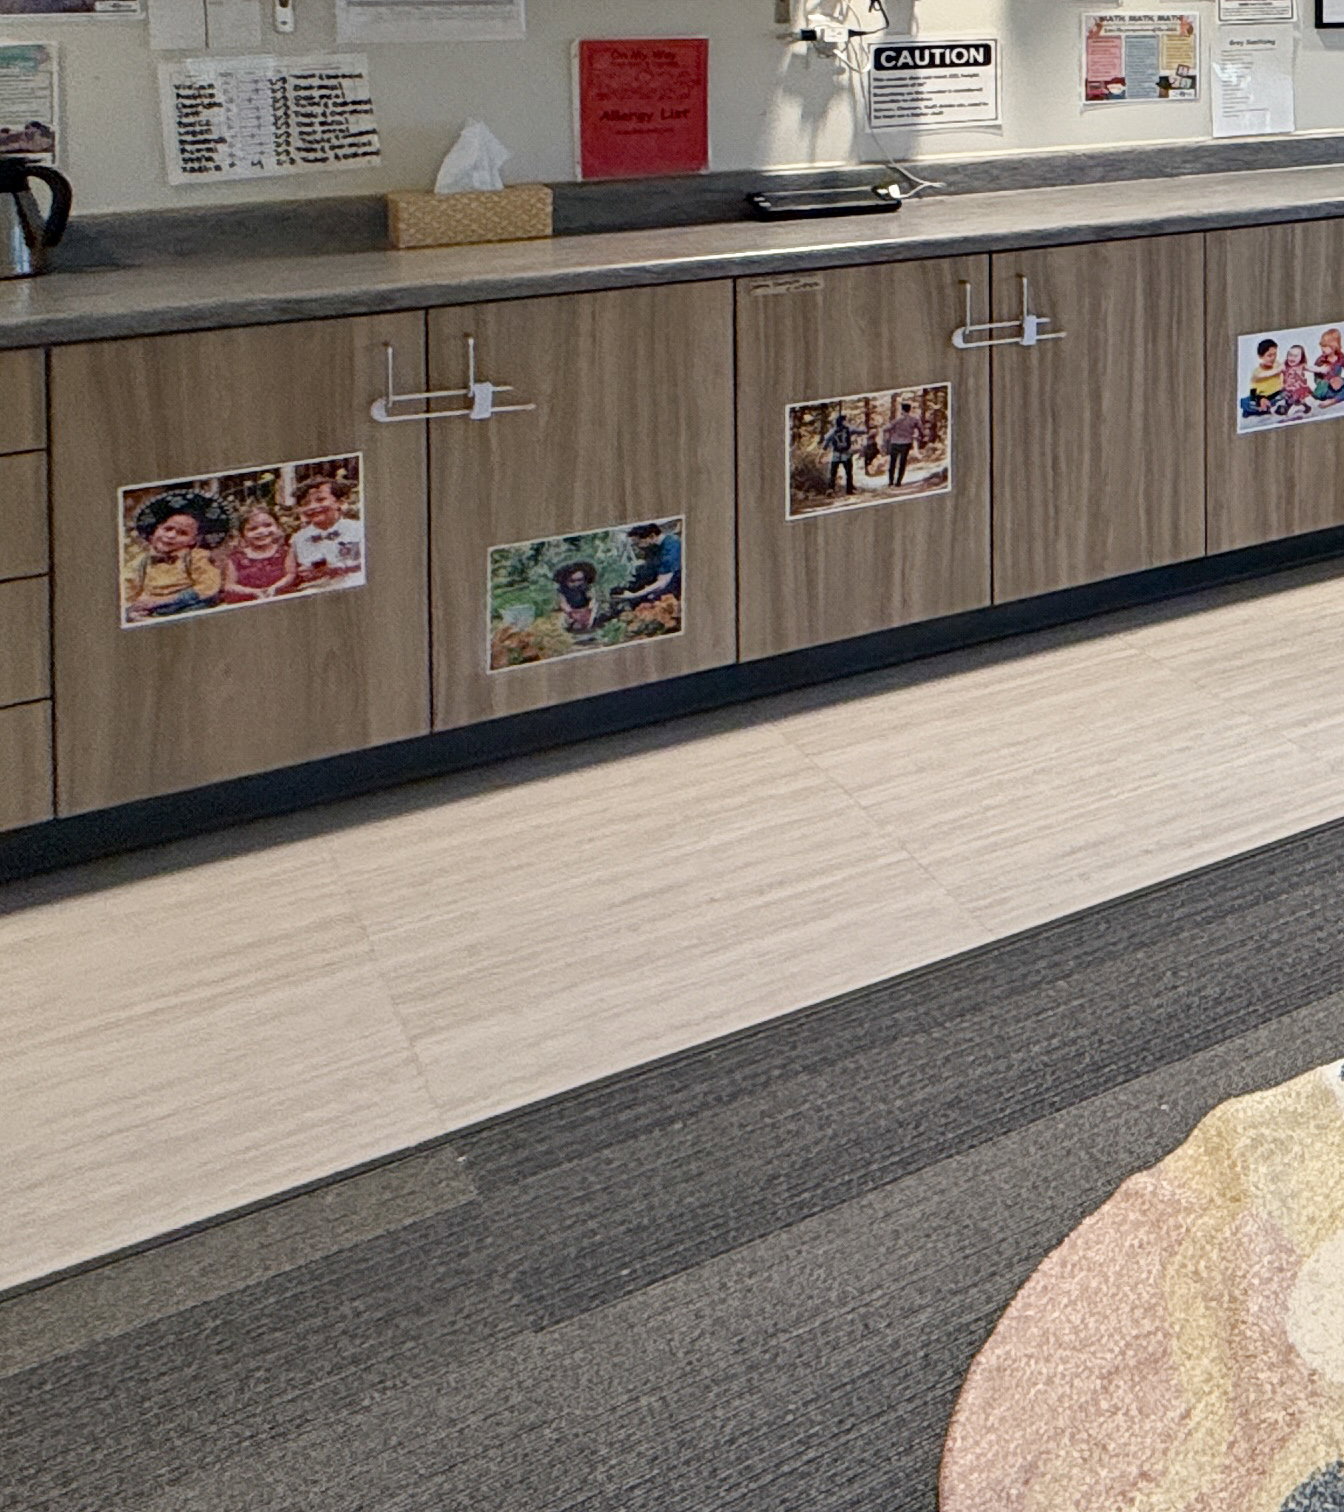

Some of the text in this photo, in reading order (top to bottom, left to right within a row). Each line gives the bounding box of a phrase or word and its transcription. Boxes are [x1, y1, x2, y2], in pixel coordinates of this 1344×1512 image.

[631, 50, 647, 61] My
[653, 50, 676, 60] Way
[880, 48, 984, 67] CAUTION
